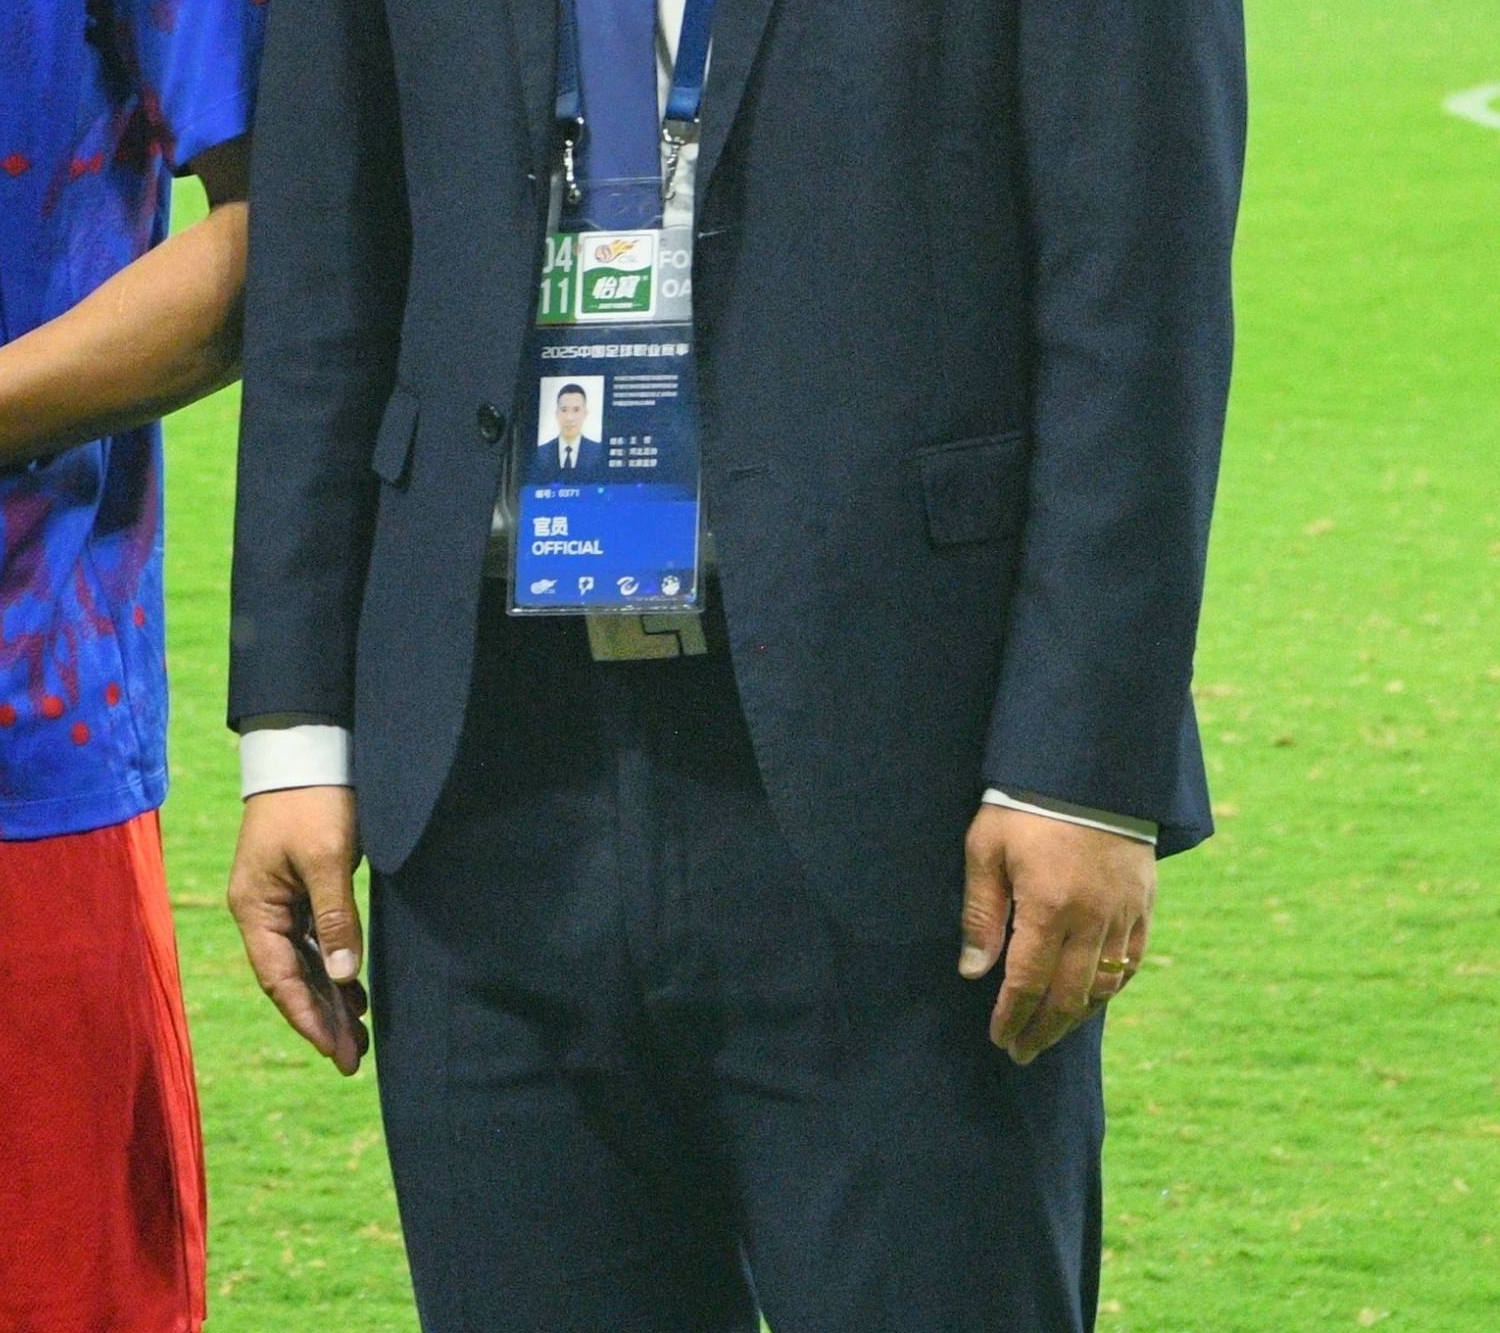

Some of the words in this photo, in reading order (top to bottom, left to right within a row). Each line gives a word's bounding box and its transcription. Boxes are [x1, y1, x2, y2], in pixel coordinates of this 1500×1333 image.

[541, 342, 690, 359] 2025中国足球职业赛事
[533, 516, 568, 537] 官员
[531, 540, 604, 556] OFFICIAL
